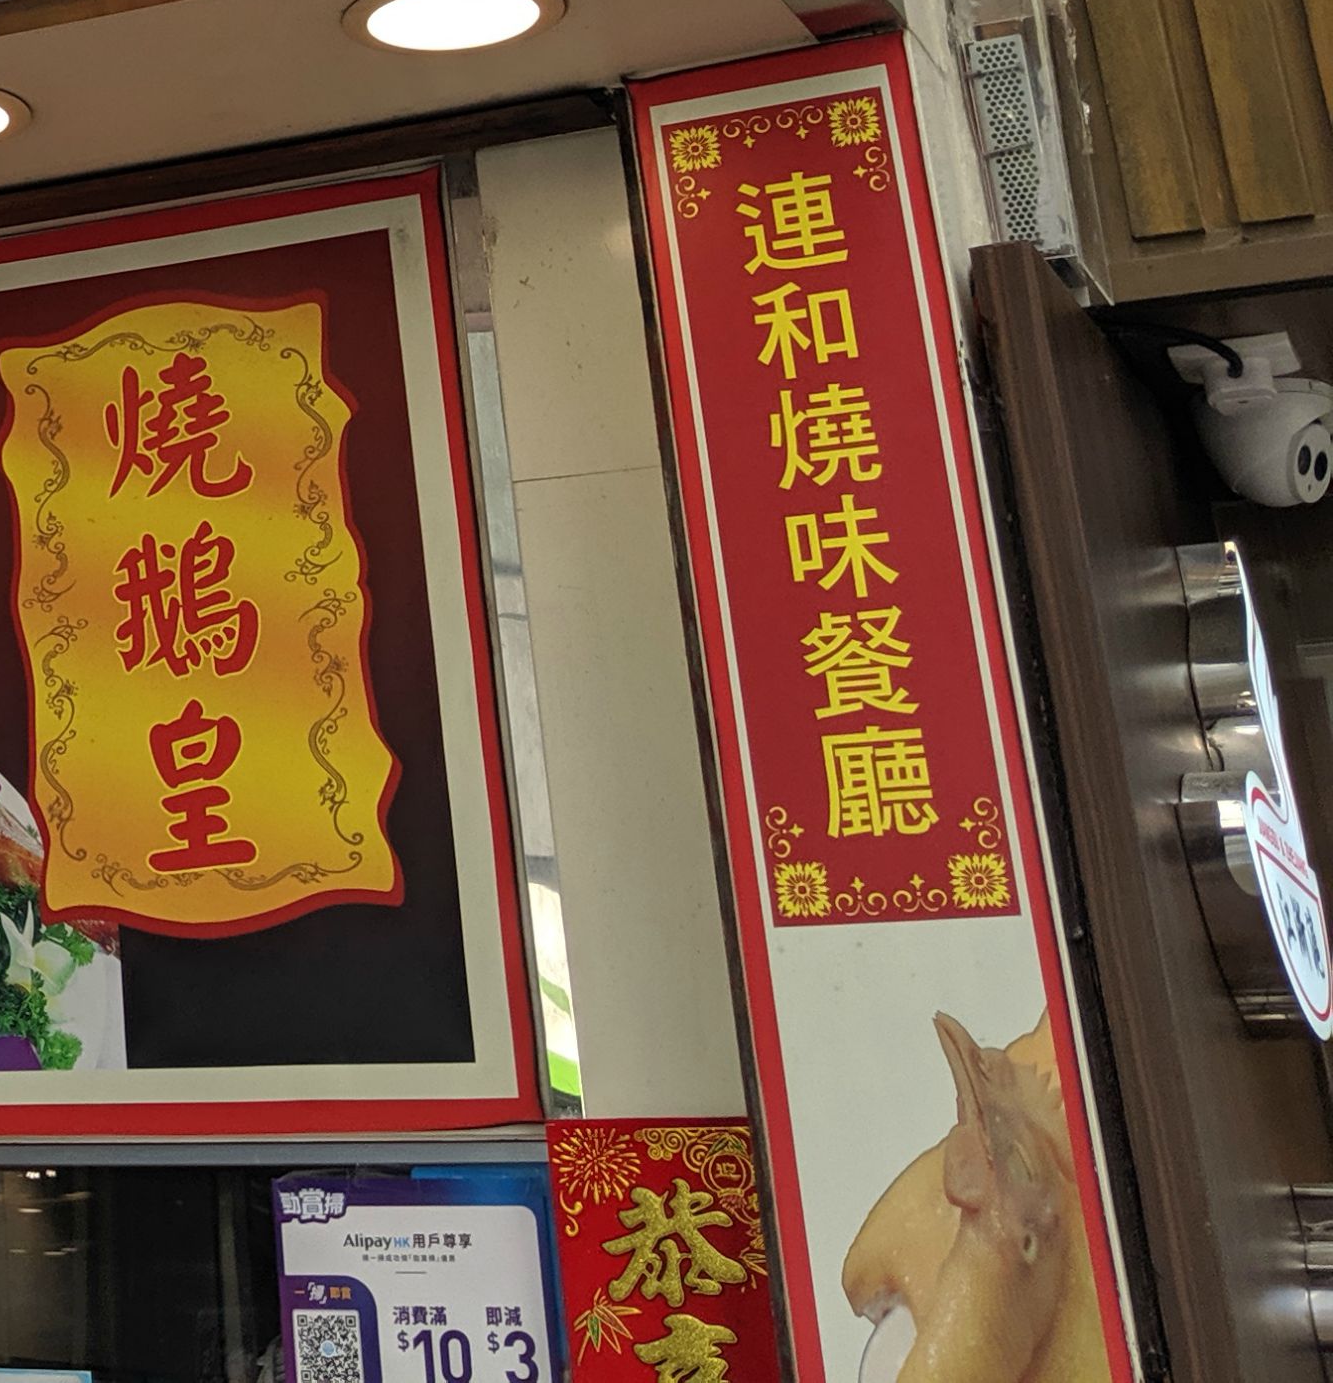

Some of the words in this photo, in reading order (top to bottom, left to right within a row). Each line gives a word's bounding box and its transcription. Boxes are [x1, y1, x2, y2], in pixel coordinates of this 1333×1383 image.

[735, 169, 940, 840] 連和燒味餐廳
[101, 352, 260, 874] 燒鵝皇
[411, 1232, 472, 1249] 用戶尊享
[392, 1305, 448, 1327] 消費滿
[485, 1306, 523, 1327] 即減
[397, 1329, 473, 1383] $10
[486, 1329, 540, 1383] $3
